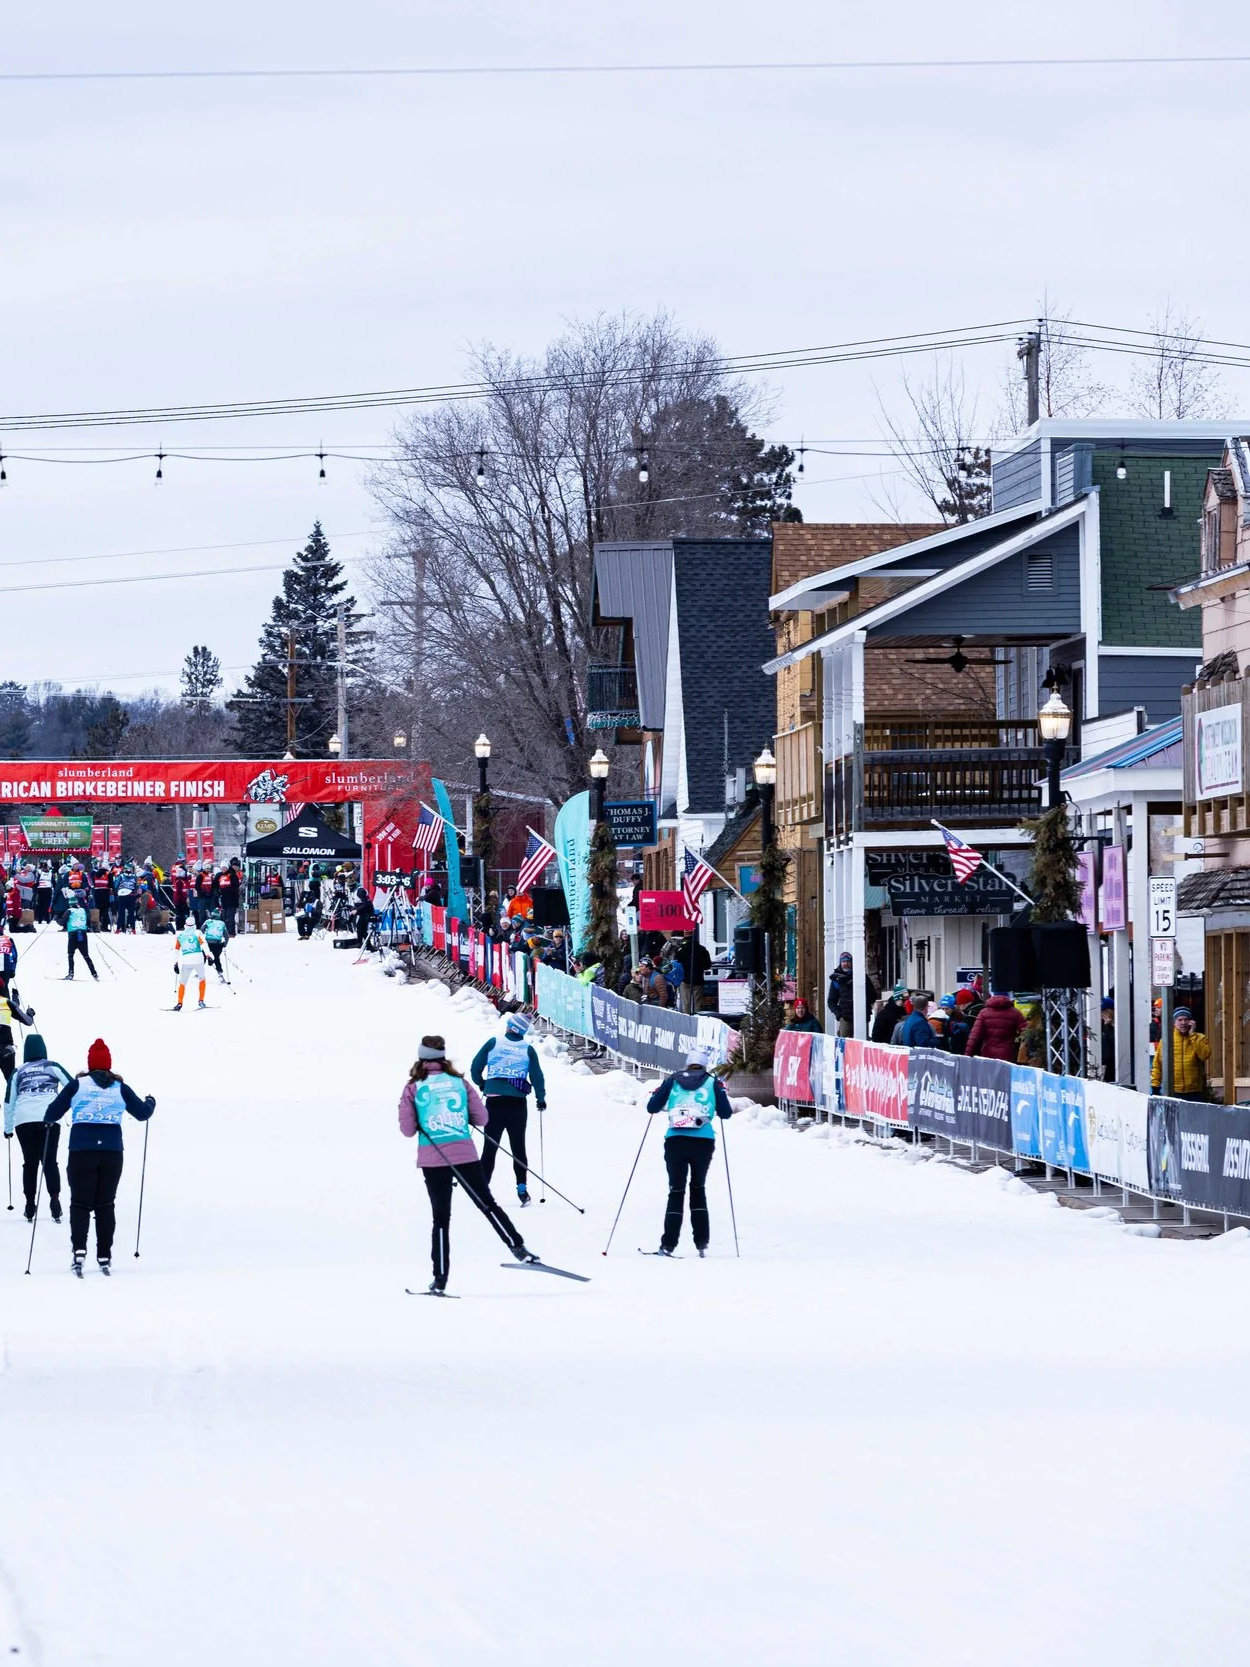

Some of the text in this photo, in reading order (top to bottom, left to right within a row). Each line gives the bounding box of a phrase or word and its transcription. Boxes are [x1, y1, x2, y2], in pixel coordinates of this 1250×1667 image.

[58, 767, 133, 778] slumberland
[56, 781, 166, 798] BIRKEBEINER
[170, 780, 225, 798] FINISH
[607, 807, 643, 816] HOMAS
[613, 815, 643, 823] DUFFY
[608, 826, 651, 834] TTORNEY
[282, 846, 335, 856] SALOMON
[890, 874, 1013, 894] Silver Star
[1151, 883, 1174, 893] SPEED
[920, 895, 982, 903] MARKET
[1153, 896, 1172, 905] LIMIT
[657, 903, 683, 918] 100
[933, 904, 969, 915] threads
[1155, 910, 1171, 932] 15
